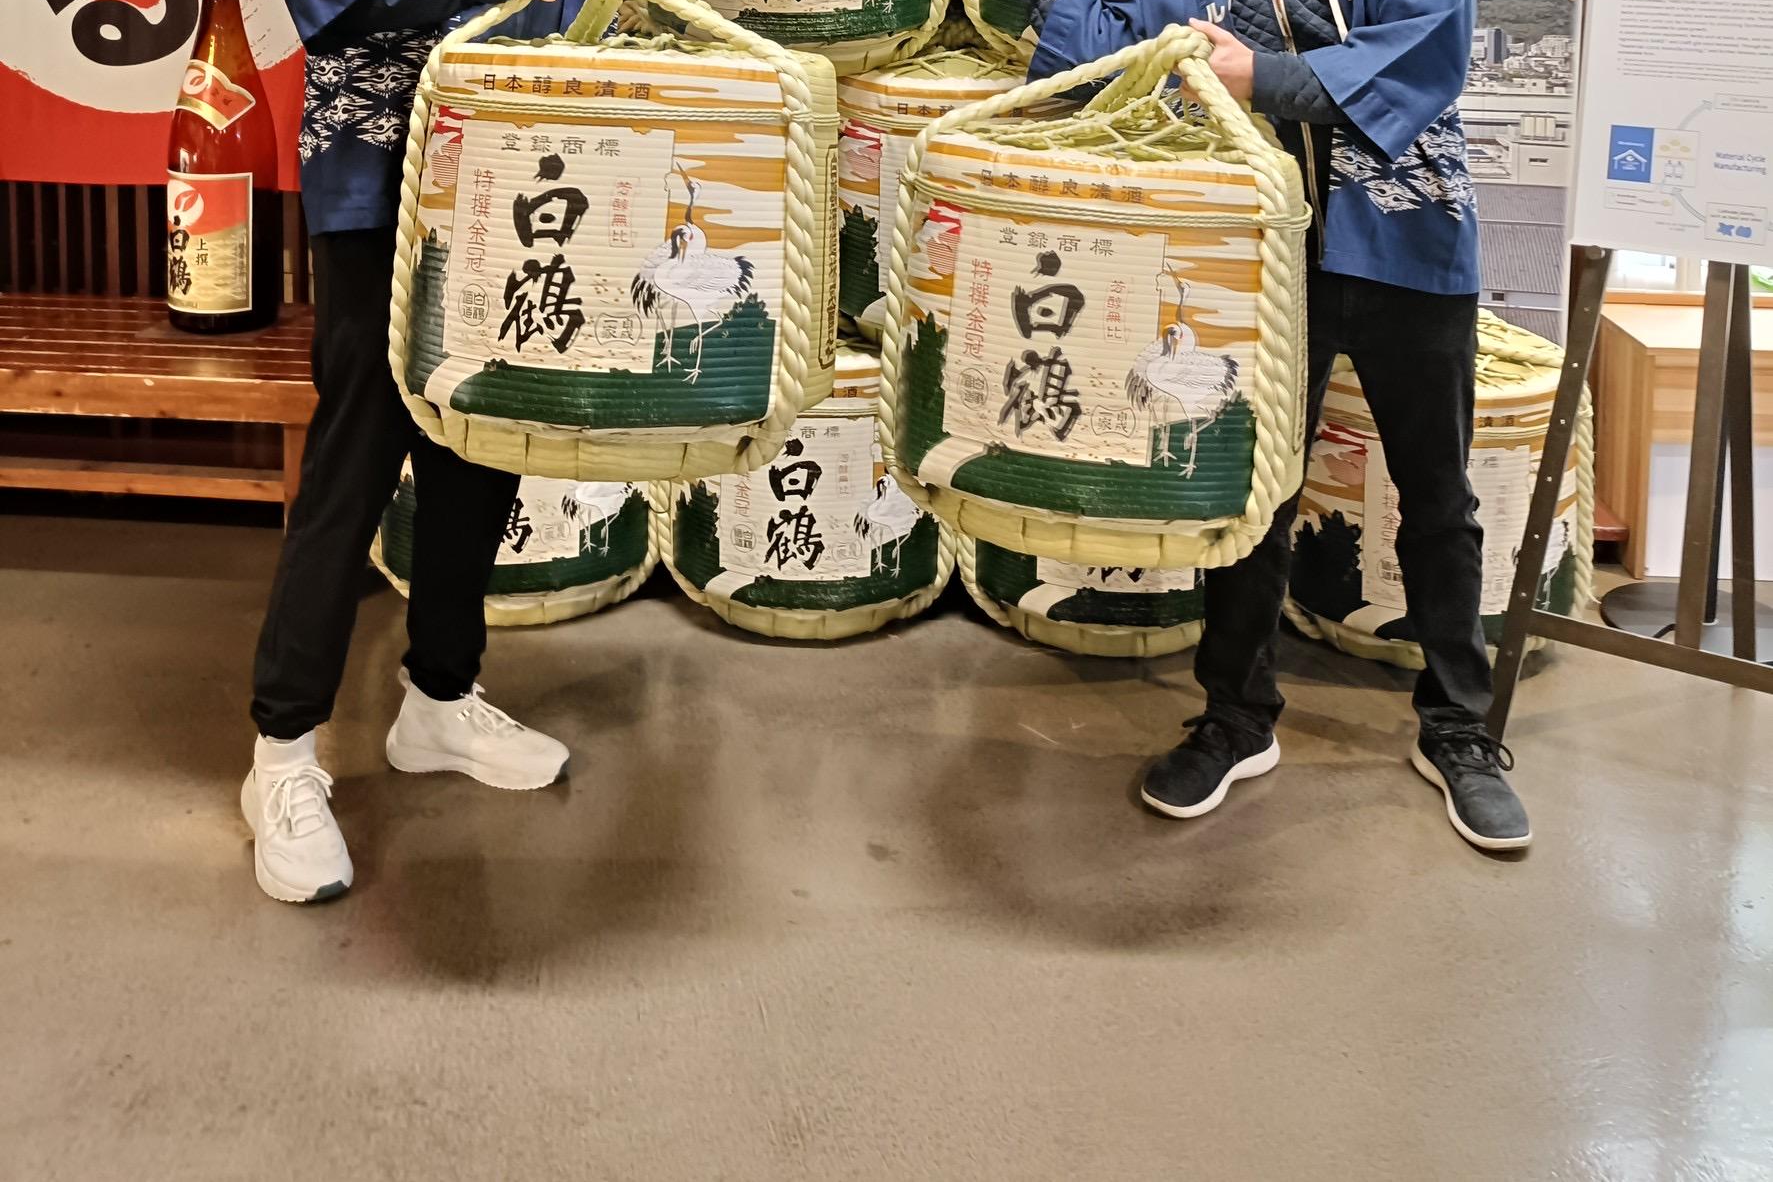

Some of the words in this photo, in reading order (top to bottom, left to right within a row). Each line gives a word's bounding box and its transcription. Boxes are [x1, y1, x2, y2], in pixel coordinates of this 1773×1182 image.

[484, 74, 652, 100] 日本醇良清酒
[500, 133, 621, 158] 登録商標
[465, 168, 496, 272] 特撰金冠
[498, 154, 589, 353] 白鶴
[997, 251, 1086, 442] 白鶴
[787, 426, 840, 440] 商標
[764, 437, 825, 570] 白鶴
